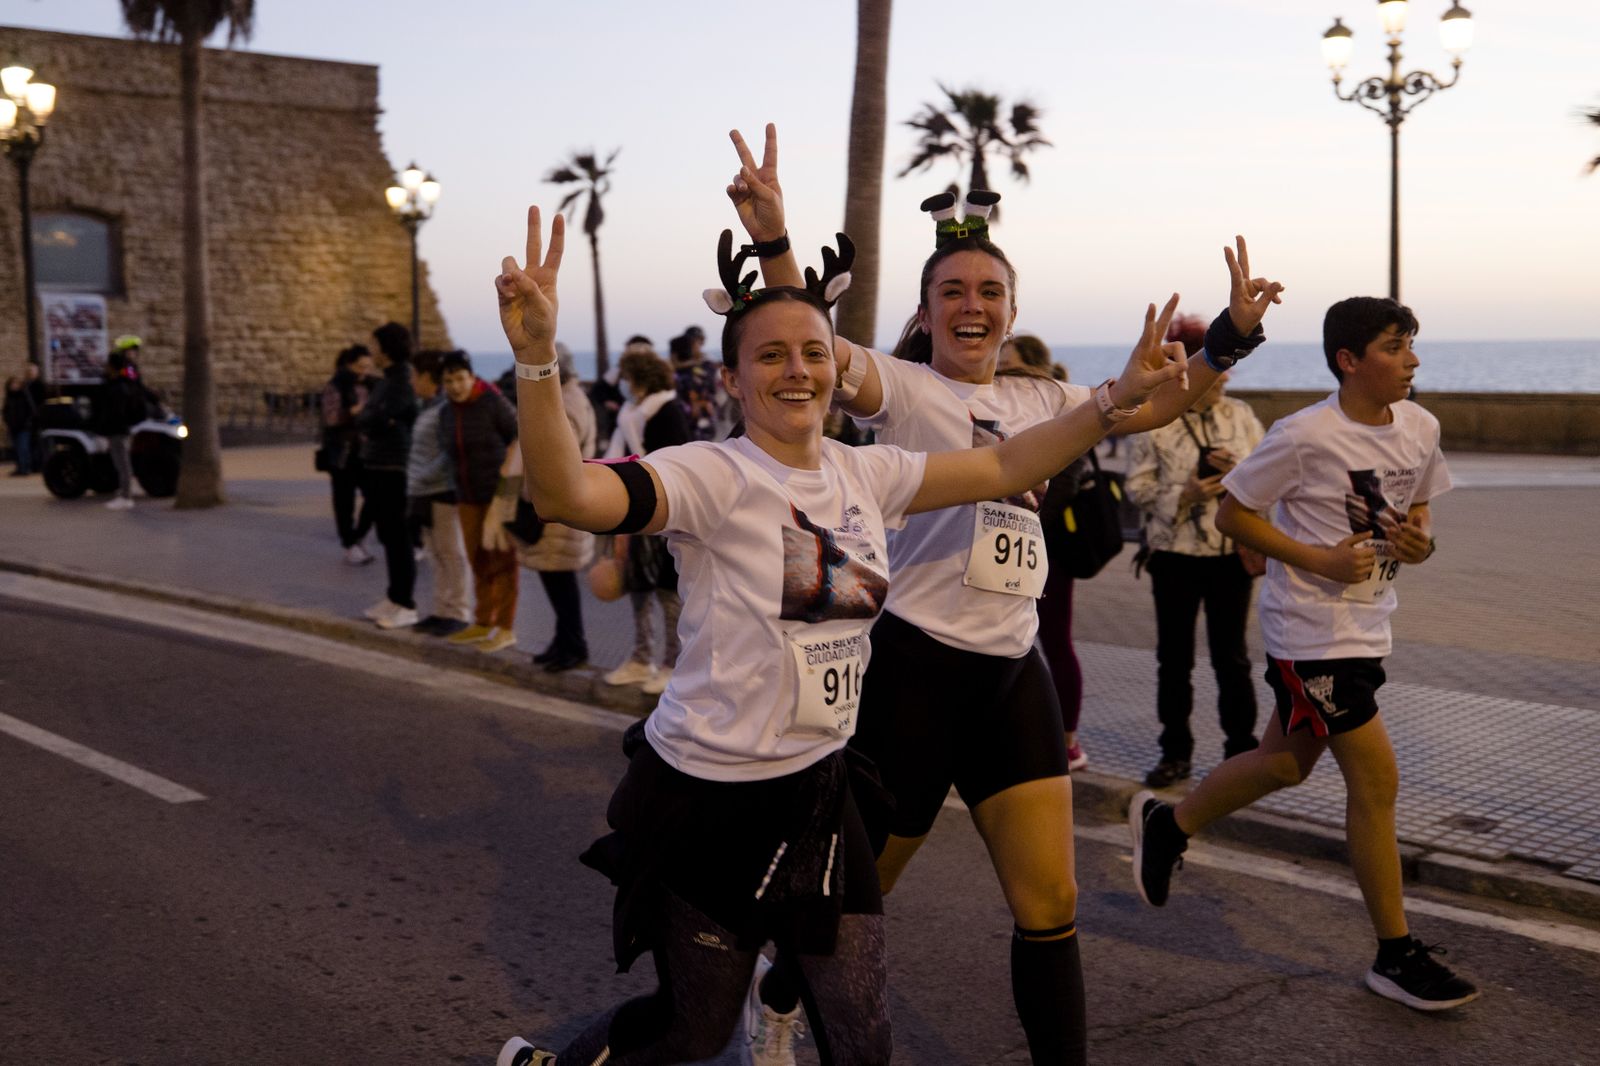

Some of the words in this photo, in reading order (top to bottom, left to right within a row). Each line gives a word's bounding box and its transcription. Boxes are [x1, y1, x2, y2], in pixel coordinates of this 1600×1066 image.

[983, 508, 1006, 519] SAN
[983, 515, 1018, 530] CIUDAD
[994, 533, 1037, 570] 915
[804, 641, 831, 654] SAN
[806, 647, 845, 666] CIUDAD
